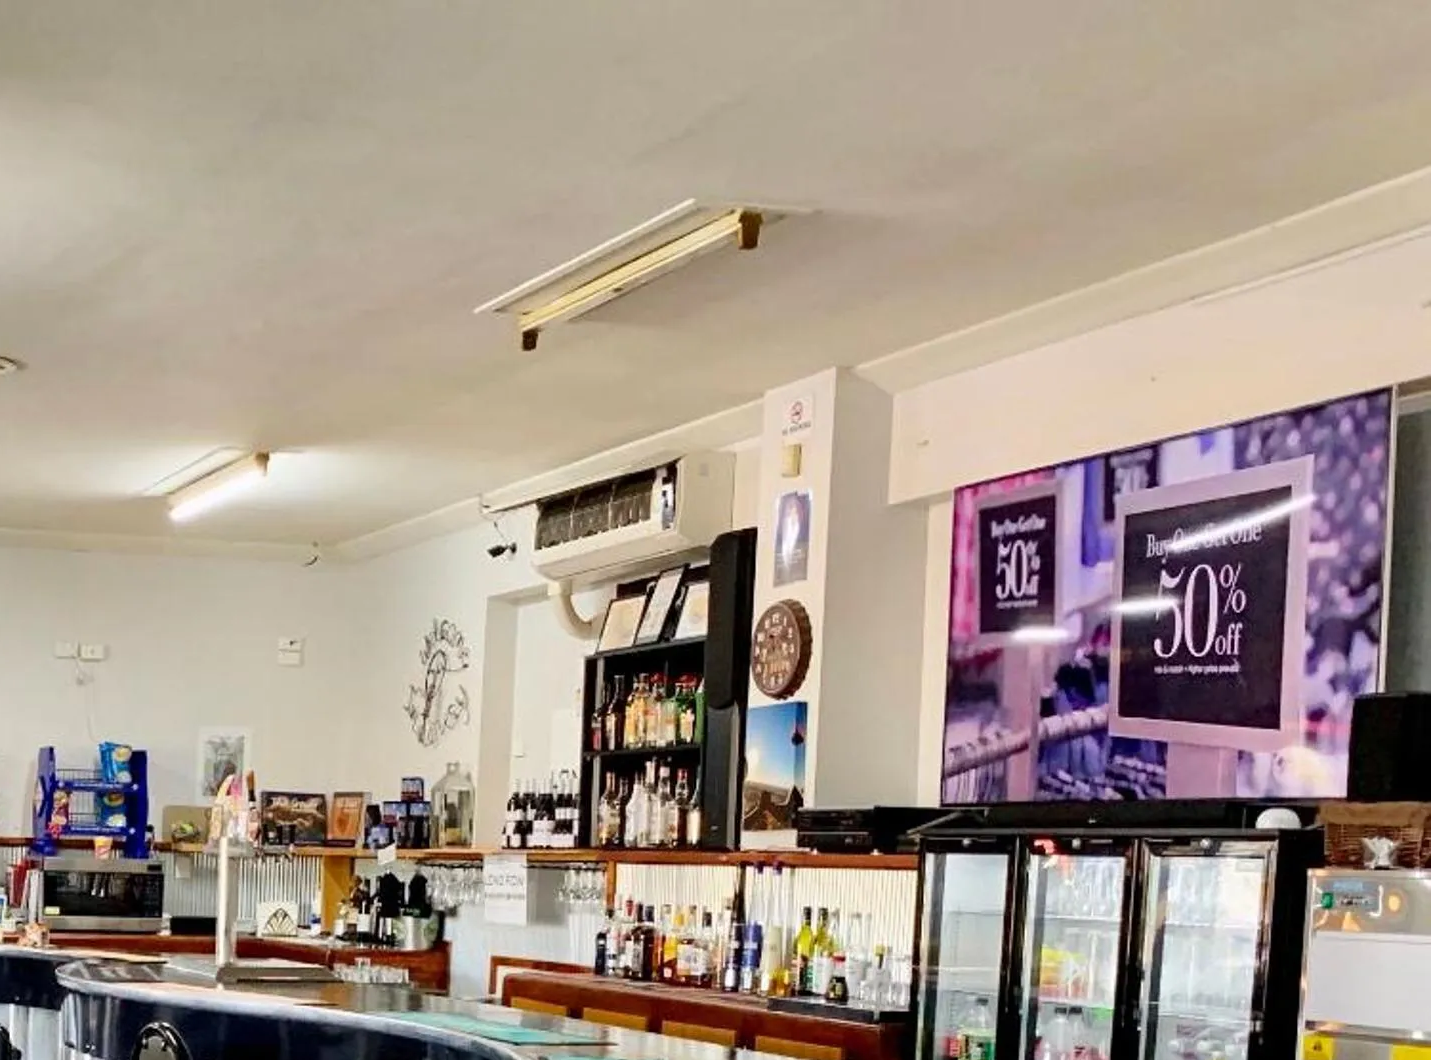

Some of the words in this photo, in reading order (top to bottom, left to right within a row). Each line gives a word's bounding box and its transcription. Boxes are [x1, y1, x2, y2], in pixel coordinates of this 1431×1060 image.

[995, 540, 1041, 600] 50%
[1153, 561, 1247, 658] 50%
[1214, 622, 1244, 656] off
